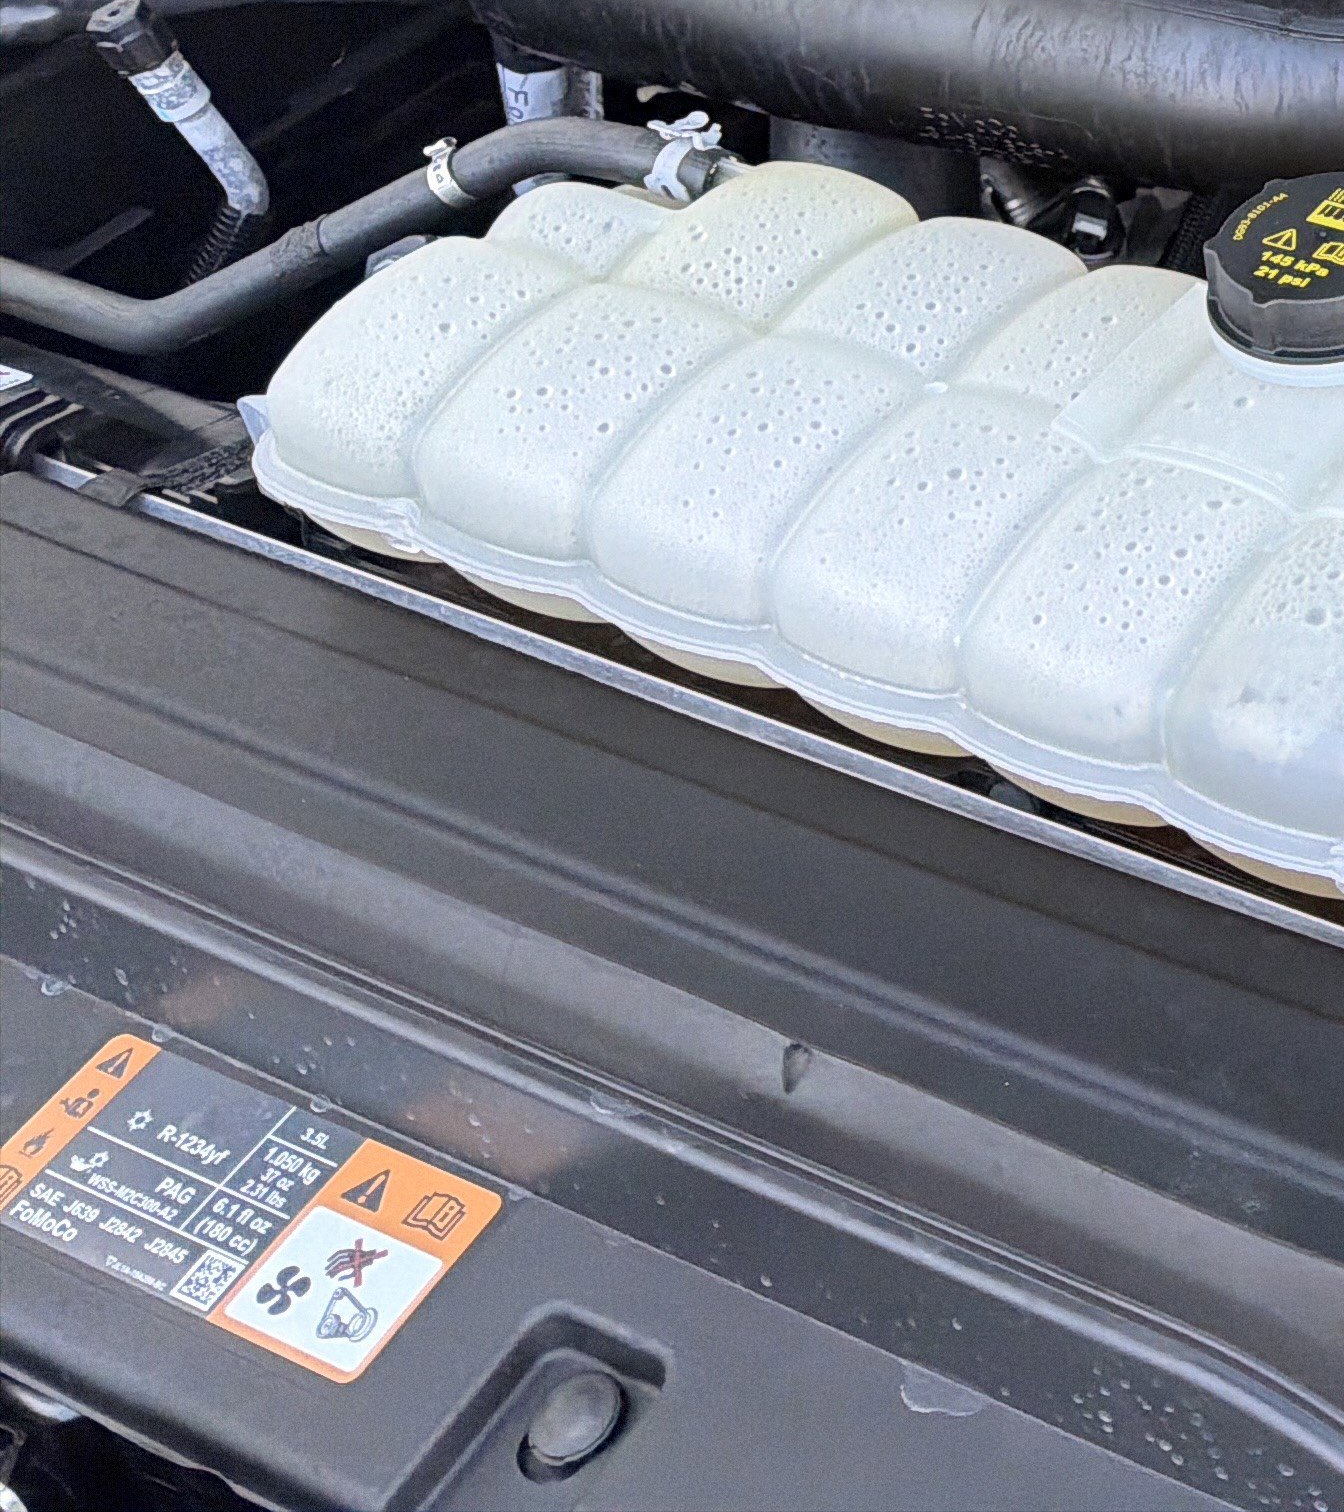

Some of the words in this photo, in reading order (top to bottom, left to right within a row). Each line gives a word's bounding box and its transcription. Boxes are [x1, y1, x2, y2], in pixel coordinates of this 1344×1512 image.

[1253, 265, 1280, 280] 21
[1277, 274, 1312, 288] psi
[1261, 250, 1296, 267] 145
[1294, 259, 1330, 277] kPa
[156, 1124, 231, 1166] R-1234yf
[300, 1127, 331, 1151] 3.5L
[260, 1167, 282, 1184] 37
[276, 1177, 295, 1192] oz
[263, 1146, 304, 1174] 1.050
[299, 1161, 322, 1186] kg
[87, 1172, 179, 1223] WSS-M2C300-A2
[154, 1176, 197, 1206] PAG
[239, 1179, 270, 1200] 2.31
[264, 1190, 288, 1209] lbs
[8, 1199, 79, 1242] FoMoCo
[29, 1182, 66, 1207] SAE
[62, 1199, 101, 1223] J639
[99, 1216, 144, 1244] J2842
[143, 1237, 191, 1265] J2845
[212, 1197, 241, 1219] 6.1
[235, 1204, 255, 1226] fl
[249, 1216, 273, 1235] oz
[192, 1216, 233, 1243] (180
[228, 1235, 260, 1258] cc)
